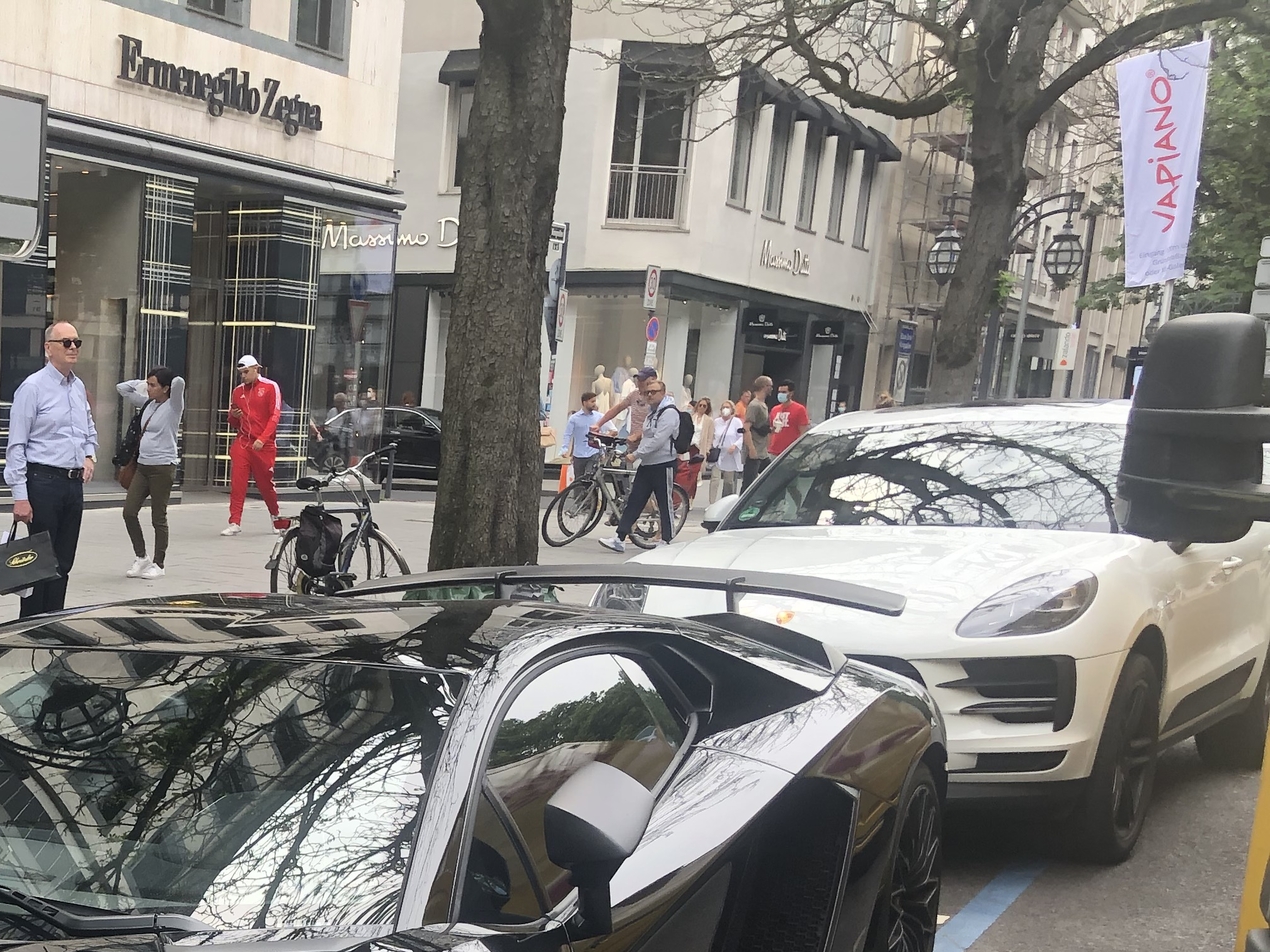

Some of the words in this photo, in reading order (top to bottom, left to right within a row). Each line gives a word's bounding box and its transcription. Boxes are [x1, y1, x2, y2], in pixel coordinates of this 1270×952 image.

[117, 34, 261, 117] Ermenegildo
[260, 78, 323, 136] Zegna
[321, 218, 430, 250] Massimo
[759, 239, 791, 271] Massimo
